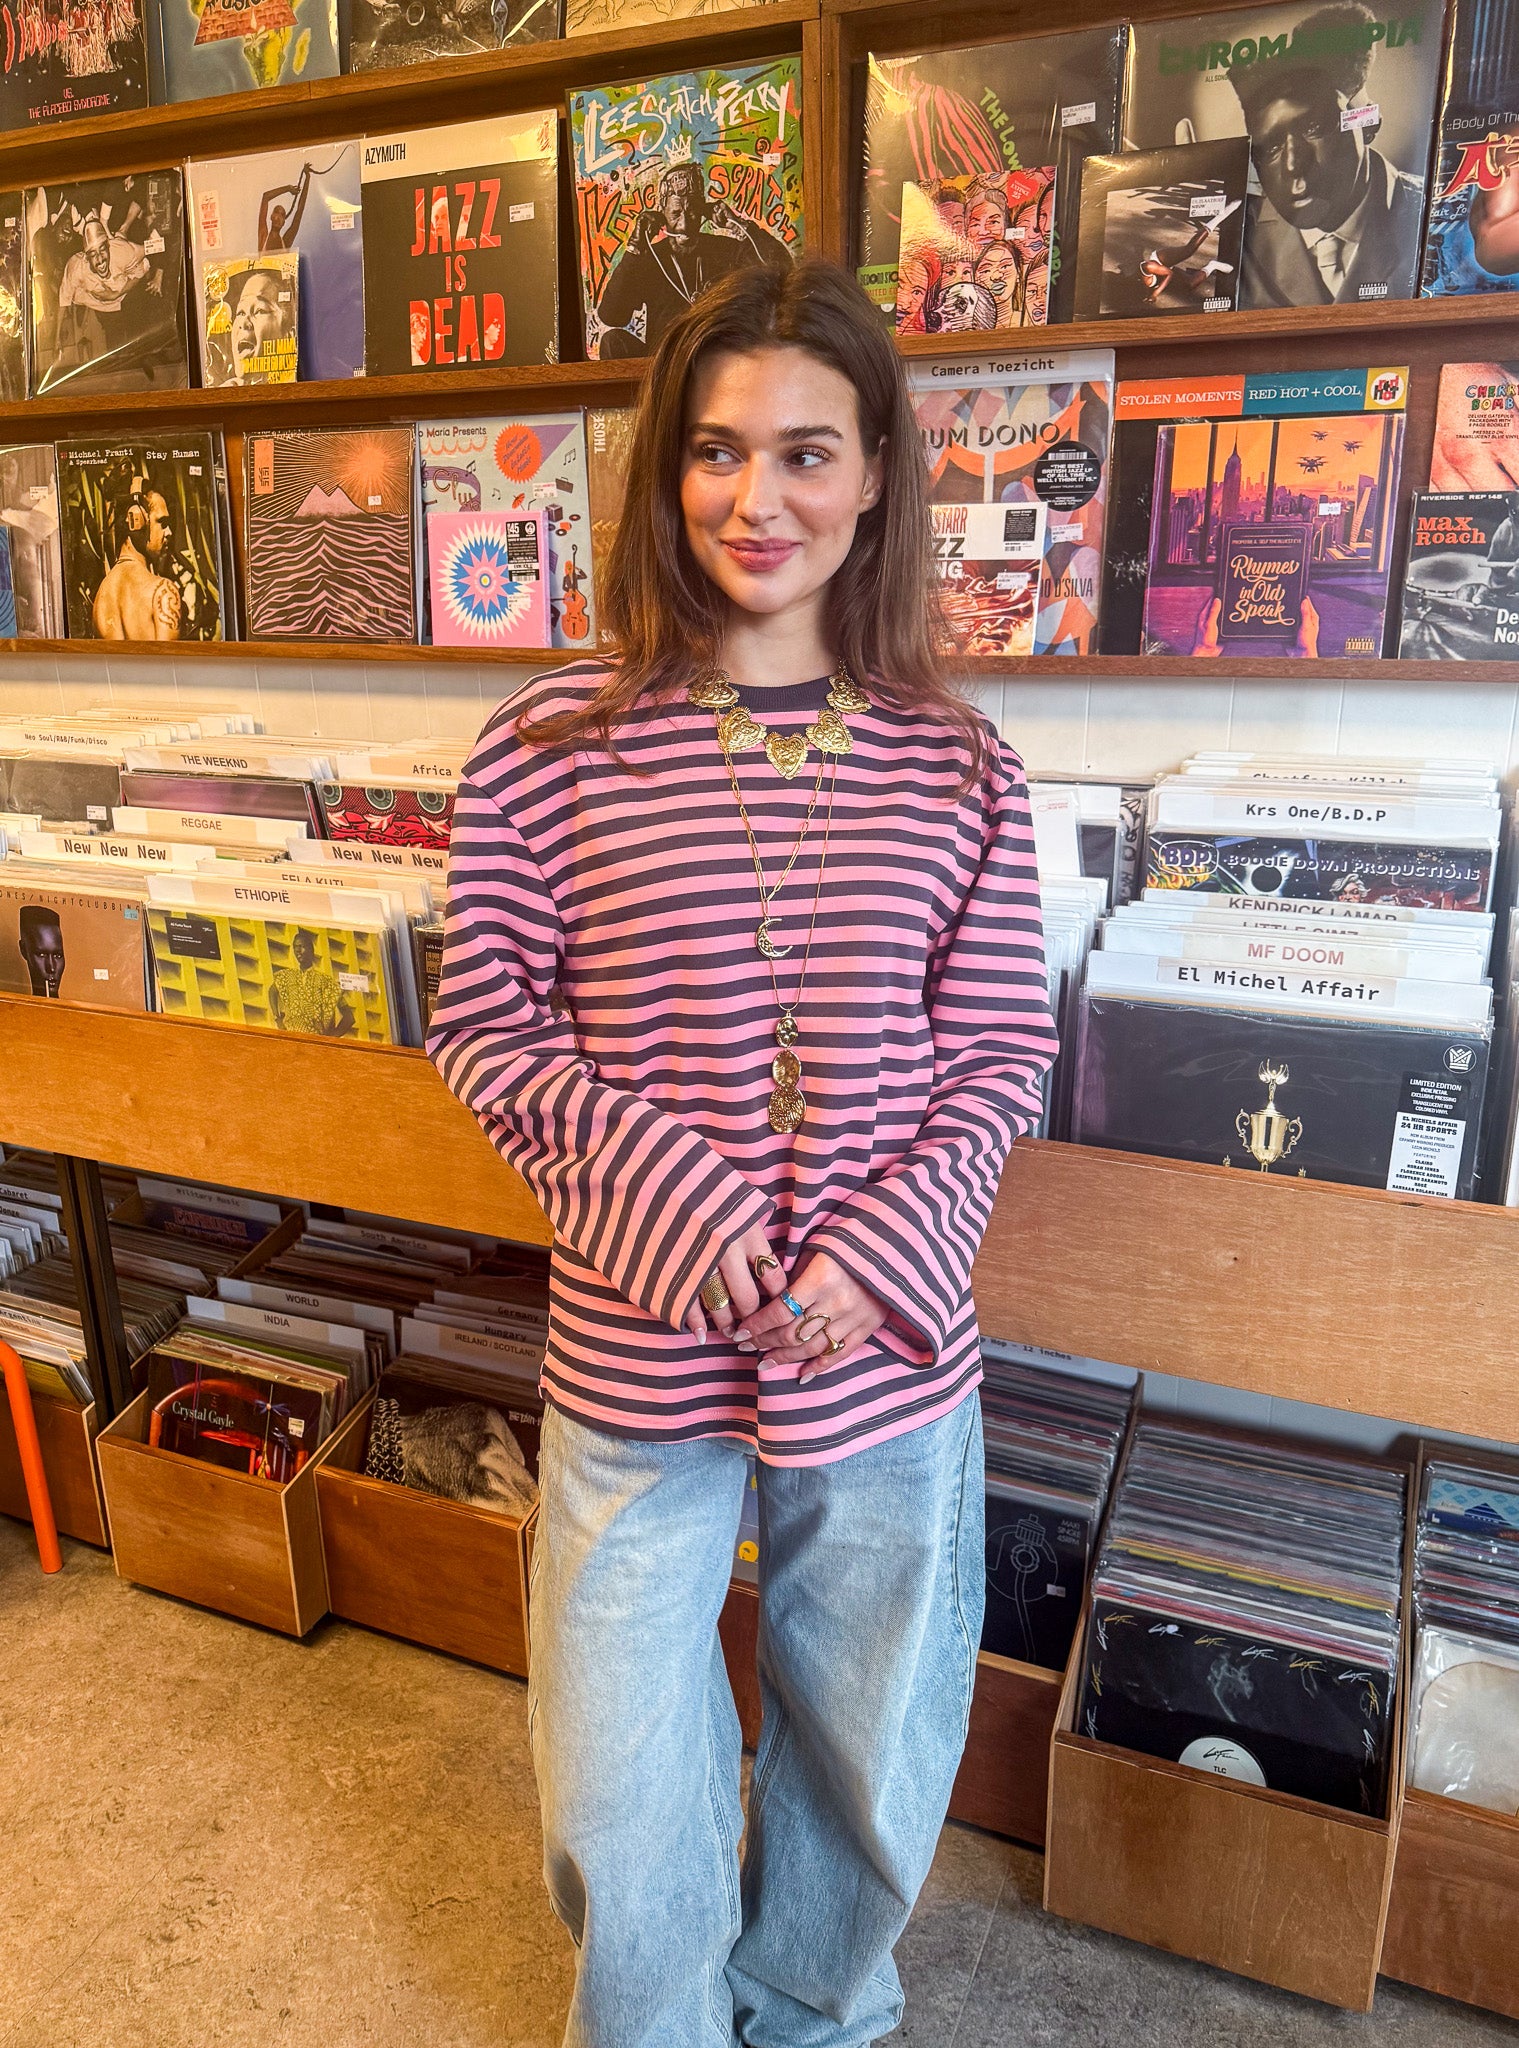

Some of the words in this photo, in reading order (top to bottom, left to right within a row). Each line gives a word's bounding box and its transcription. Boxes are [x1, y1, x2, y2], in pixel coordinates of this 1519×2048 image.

[28, 107, 41, 119] THE
[980, 86, 1009, 130] THE
[584, 99, 638, 174] LEE
[711, 79, 789, 141] PERRY
[1488, 113, 1500, 125] Of
[364, 142, 406, 166] AZYMUTH
[709, 164, 799, 243] SCRATCH
[411, 178, 502, 257] JAZZ
[445, 254, 467, 293] IS
[409, 292, 506, 367] DEAD
[932, 366, 980, 377] Camera
[988, 358, 1055, 374] Toezicht
[1120, 394, 1172, 406] STOLEN
[1174, 390, 1242, 404] MOMENTS
[1248, 389, 1278, 400] RED
[1279, 387, 1309, 400] HOT
[1465, 384, 1519, 398] CHERR
[1472, 396, 1514, 410] BOMB
[426, 427, 450, 438] María
[452, 426, 487, 437] Presents
[594, 414, 606, 454] THOSE
[979, 422, 1060, 447] DONO
[69, 450, 101, 458] Michael
[105, 448, 134, 456] Franti
[146, 451, 168, 460] Stay
[172, 450, 200, 458] Human
[1414, 528, 1486, 546] Roach
[1230, 554, 1300, 582] Rhymes
[1054, 578, 1093, 598] D'SILVA
[1240, 586, 1252, 600] in
[1251, 580, 1286, 602] Old
[1228, 599, 1296, 626] Speak
[181, 754, 200, 766] THE
[203, 756, 248, 769] WEEKND
[412, 764, 452, 776] Africa
[1246, 804, 1276, 817] Krs
[1288, 806, 1386, 822] One/B.D.P
[181, 817, 222, 830] REGGAE
[64, 840, 92, 854] New
[100, 843, 128, 858] New
[137, 845, 166, 861] New
[332, 846, 362, 862] New
[372, 850, 402, 865] New
[412, 853, 444, 869] New
[1164, 848, 1212, 867] BDP
[1227, 854, 1288, 868] BOOGIE
[1294, 858, 1348, 872] DOWN
[1352, 860, 1481, 881] PRODUCTIONS
[234, 888, 291, 903] ETHIOPIË
[1248, 943, 1276, 959] MF
[1282, 946, 1344, 966] DOOM
[1178, 966, 1200, 982] El
[1214, 970, 1288, 992] Michel
[1302, 980, 1380, 1002] Affair
[1410, 1079, 1435, 1088] LIMITED
[1436, 1082, 1462, 1091] EDITION
[1411, 1117, 1436, 1125] MICHELS
[1438, 1120, 1458, 1128] AFFAIR
[1426, 1126, 1457, 1135] SPORTS
[361, 1230, 386, 1242] South
[391, 1234, 428, 1250] America
[285, 1294, 320, 1308] WORLD
[264, 1314, 290, 1328] INDIA
[497, 1306, 539, 1323] Germany
[484, 1326, 527, 1342] Hungary
[454, 1333, 488, 1347] IRELAND
[493, 1342, 536, 1358] SCOTLAND
[1040, 1349, 1072, 1360] inches
[172, 1401, 206, 1422] Crystal
[208, 1409, 234, 1430] Gayle
[1213, 1766, 1227, 1774] TLC
